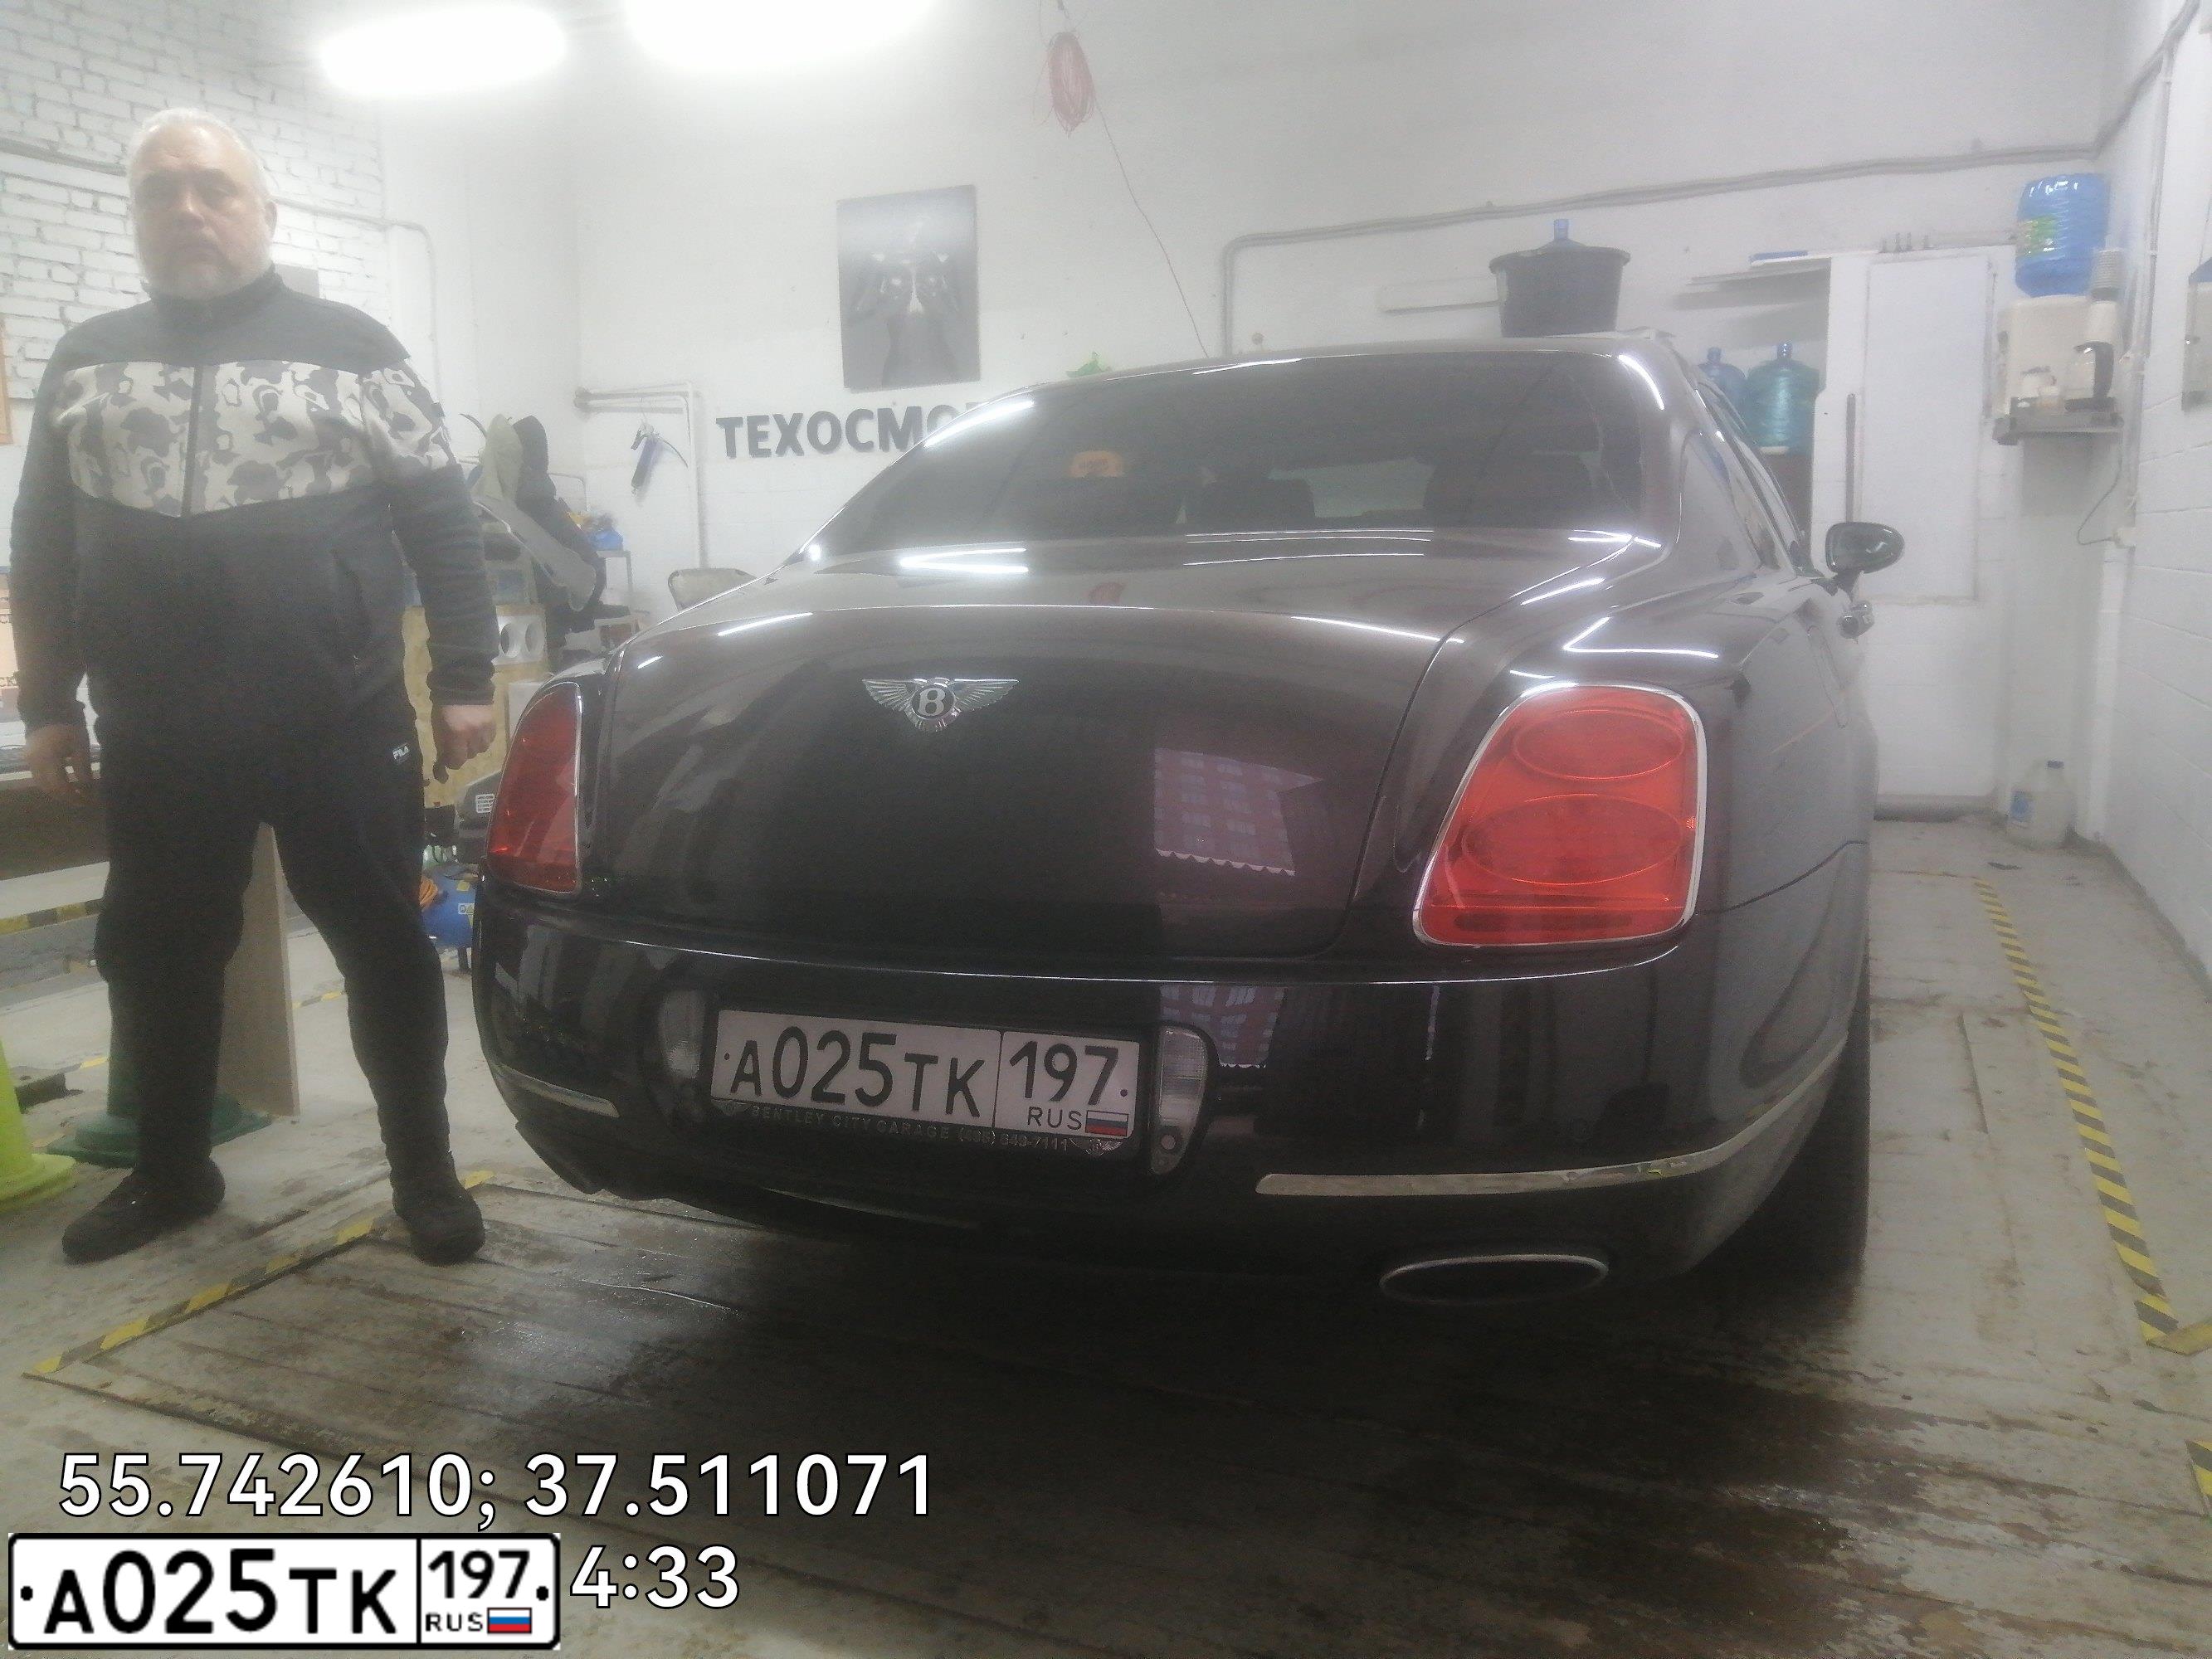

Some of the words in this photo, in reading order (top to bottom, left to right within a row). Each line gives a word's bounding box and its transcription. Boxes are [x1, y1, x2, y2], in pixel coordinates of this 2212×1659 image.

[716, 401, 990, 460] ТЕХОСМО
[392, 745, 410, 761] FILA
[730, 1026, 985, 1117] А025ТК
[1009, 1040, 1118, 1106] 197
[1027, 1106, 1082, 1131] RUS
